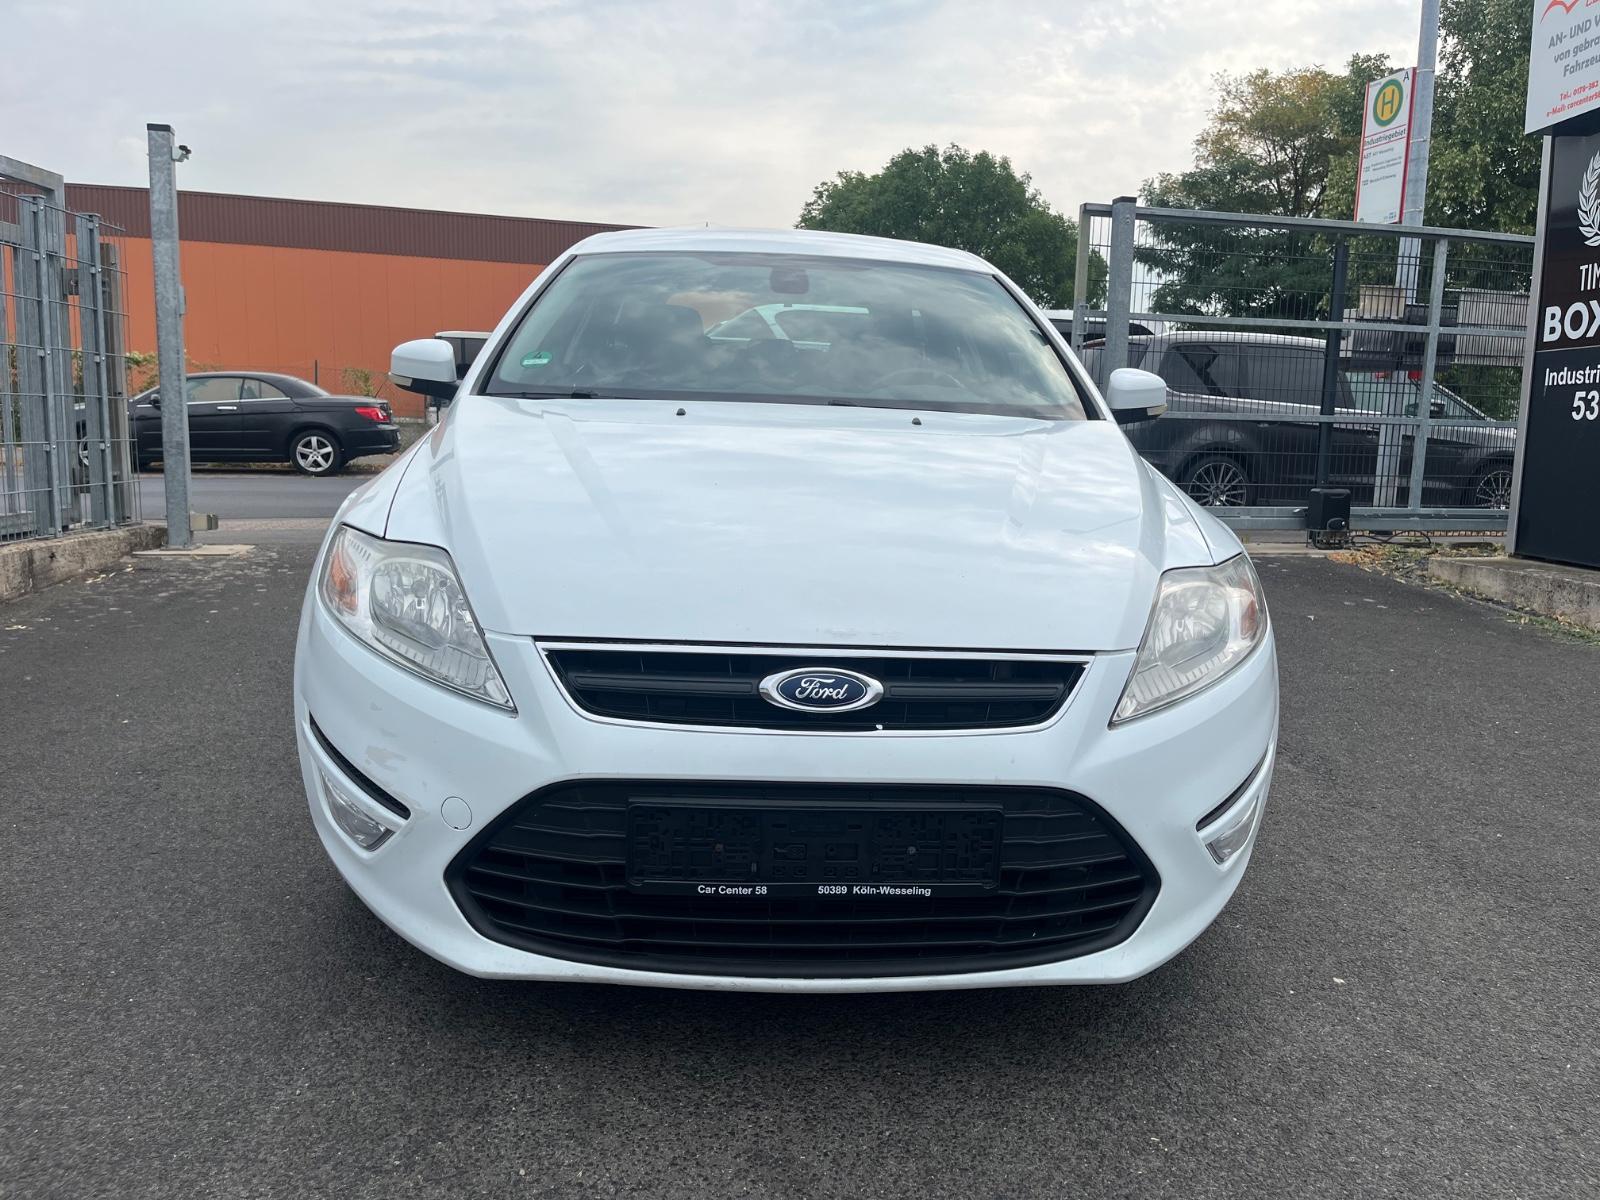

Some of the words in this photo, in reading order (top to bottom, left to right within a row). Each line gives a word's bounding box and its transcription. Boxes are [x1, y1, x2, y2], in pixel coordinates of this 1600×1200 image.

[1548, 32, 1568, 49] AN-
[1569, 19, 1592, 39] UND
[1554, 49, 1571, 63] von
[1403, 70, 1410, 81] A
[1381, 88, 1395, 117] H
[1571, 391, 1600, 421] 53
[795, 677, 849, 699] Ford
[697, 885, 716, 894] Car
[718, 885, 753, 895] Center
[755, 886, 768, 895] 58
[817, 885, 848, 894] 50389
[853, 885, 932, 896] Köln-Wesseling
